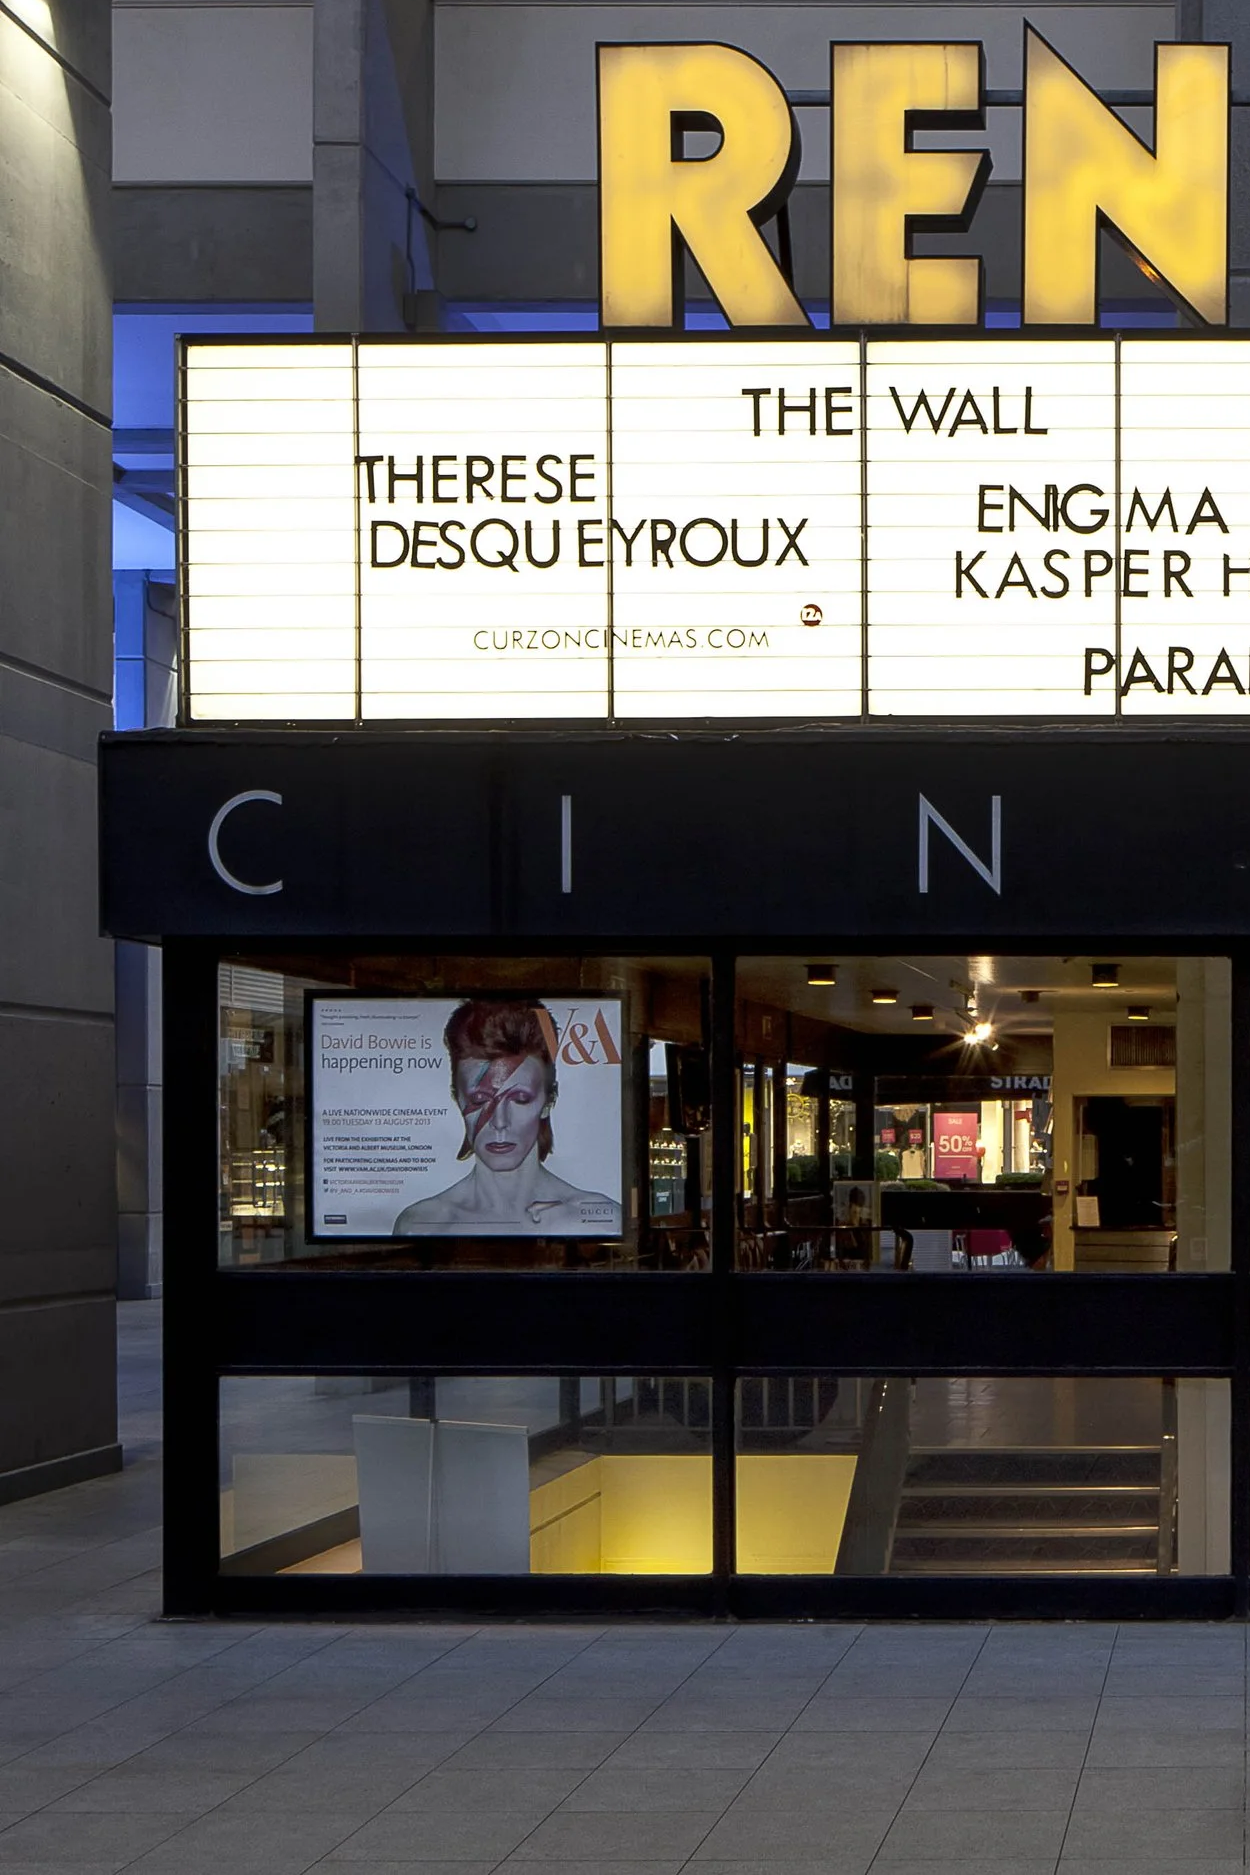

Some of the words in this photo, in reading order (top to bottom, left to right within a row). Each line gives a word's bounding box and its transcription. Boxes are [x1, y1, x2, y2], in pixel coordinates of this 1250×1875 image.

[741, 386, 855, 437] THE
[888, 386, 1049, 437] WALL
[354, 453, 596, 504] THERESE
[977, 482, 1230, 535] ENIGMA
[370, 516, 811, 572] DESQUEYROUX
[953, 548, 1193, 599] KASPER
[472, 627, 770, 650] CURZONCINEMAS.COM
[321, 1033, 363, 1050] David
[368, 1033, 417, 1050] Bowie
[420, 1034, 432, 1050] is
[533, 1007, 622, 1065] V&A
[321, 1053, 404, 1075] happening
[407, 1056, 443, 1069] now
[328, 1108, 343, 1117] LIVE
[343, 1108, 392, 1117] NATIONWIDE
[392, 1108, 423, 1117] CINEMA
[424, 1108, 448, 1117] EVENT
[383, 1118, 414, 1126] AUGUST
[938, 1134, 974, 1153] 50%
